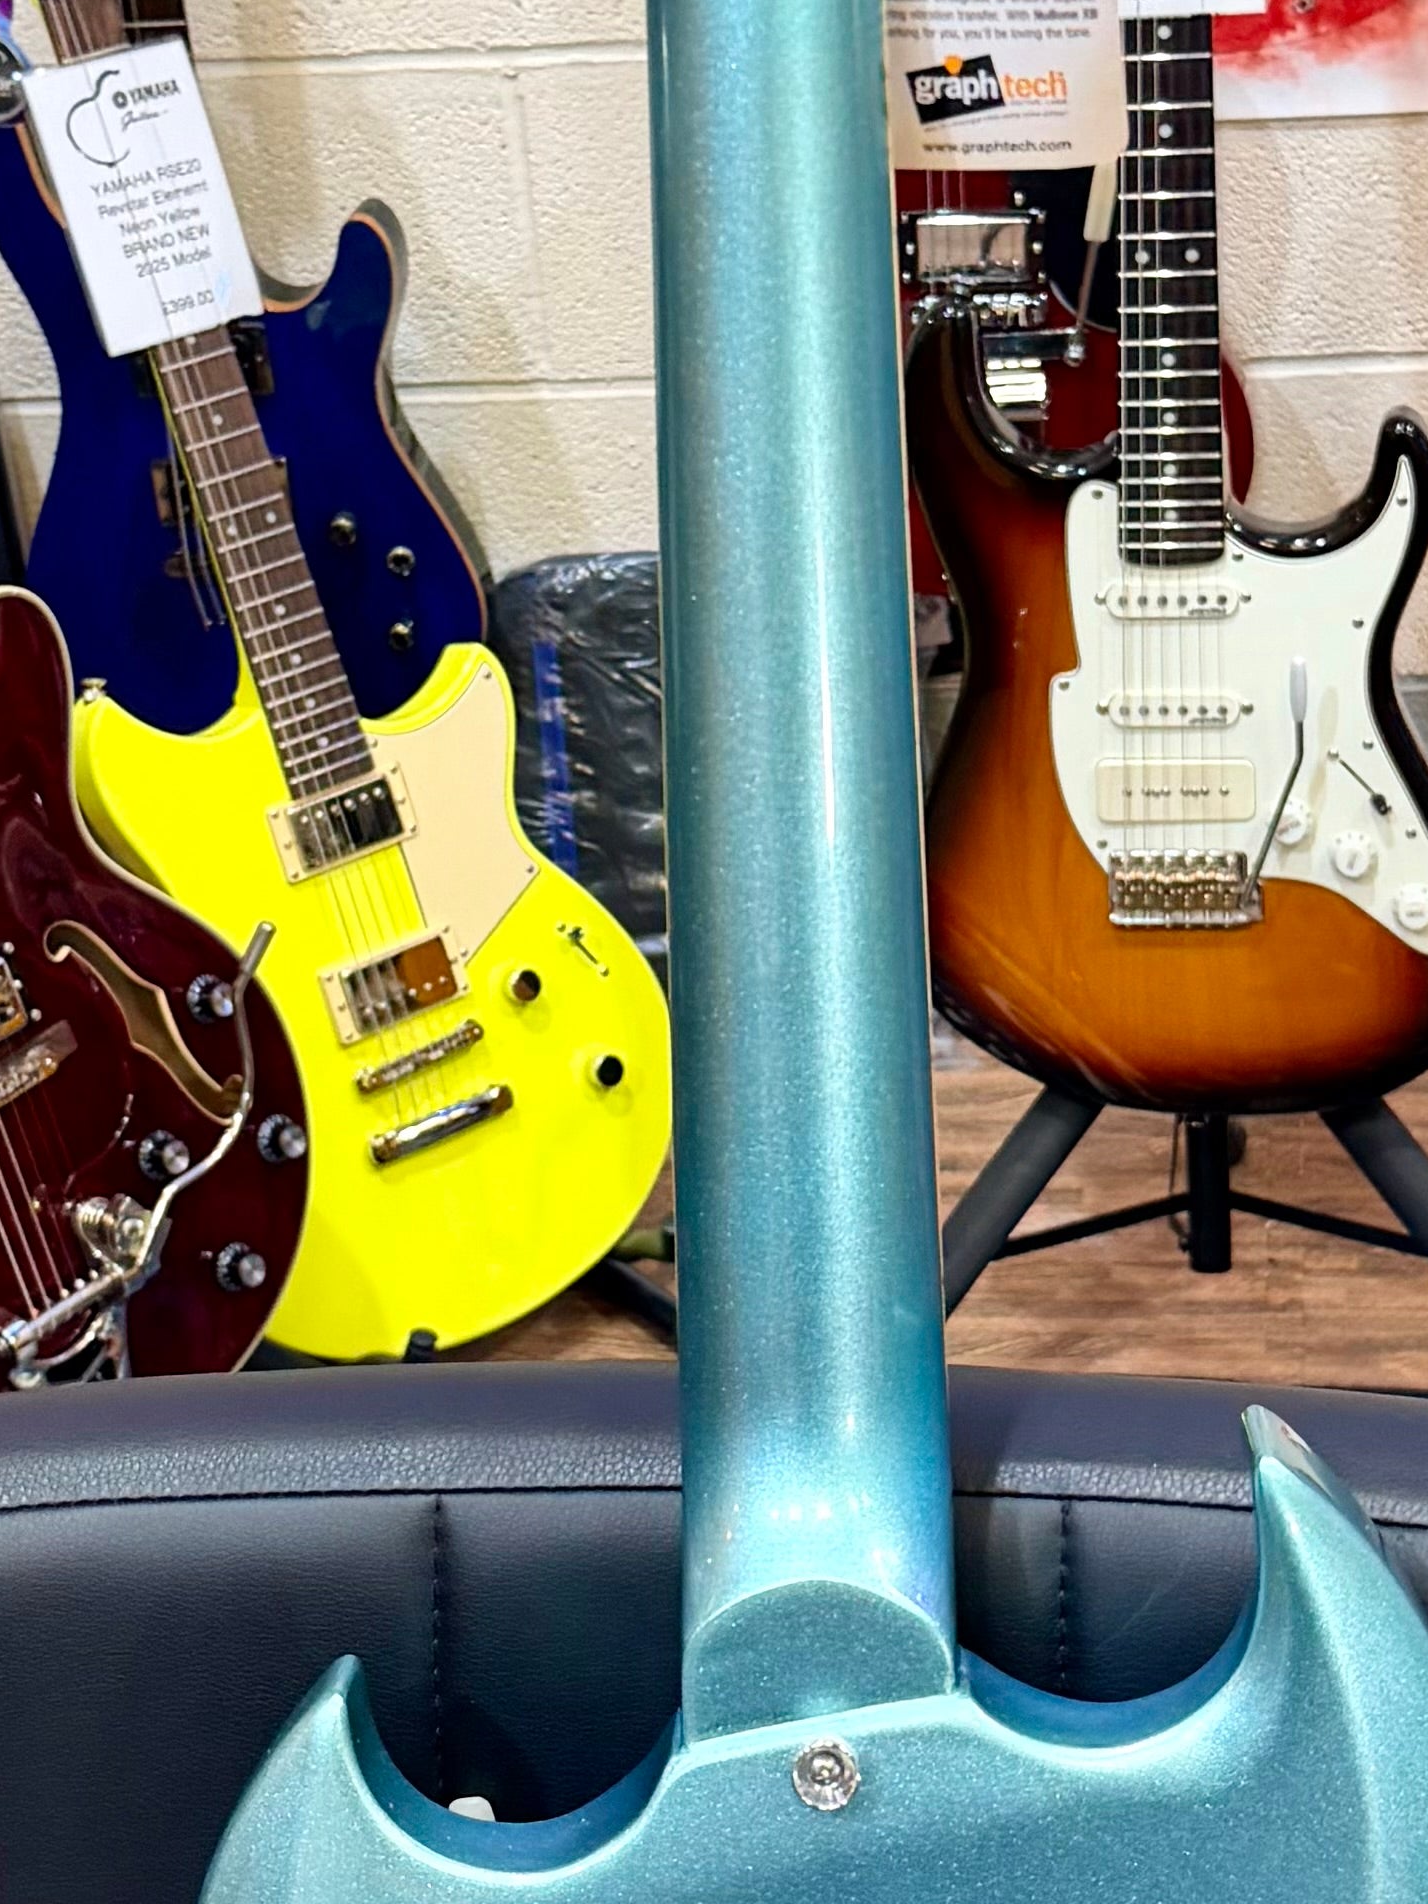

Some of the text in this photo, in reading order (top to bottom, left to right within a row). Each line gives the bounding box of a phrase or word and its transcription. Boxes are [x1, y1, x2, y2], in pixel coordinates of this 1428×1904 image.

[129, 79, 181, 105] YAMAHA
[914, 69, 1068, 105] graph tech
[922, 138, 1072, 154] www.graphtech.com
[90, 171, 155, 197] YAMAHA
[157, 207, 201, 224] Yellow
[123, 224, 210, 259] BRAND NEW
[172, 246, 213, 267] Model
